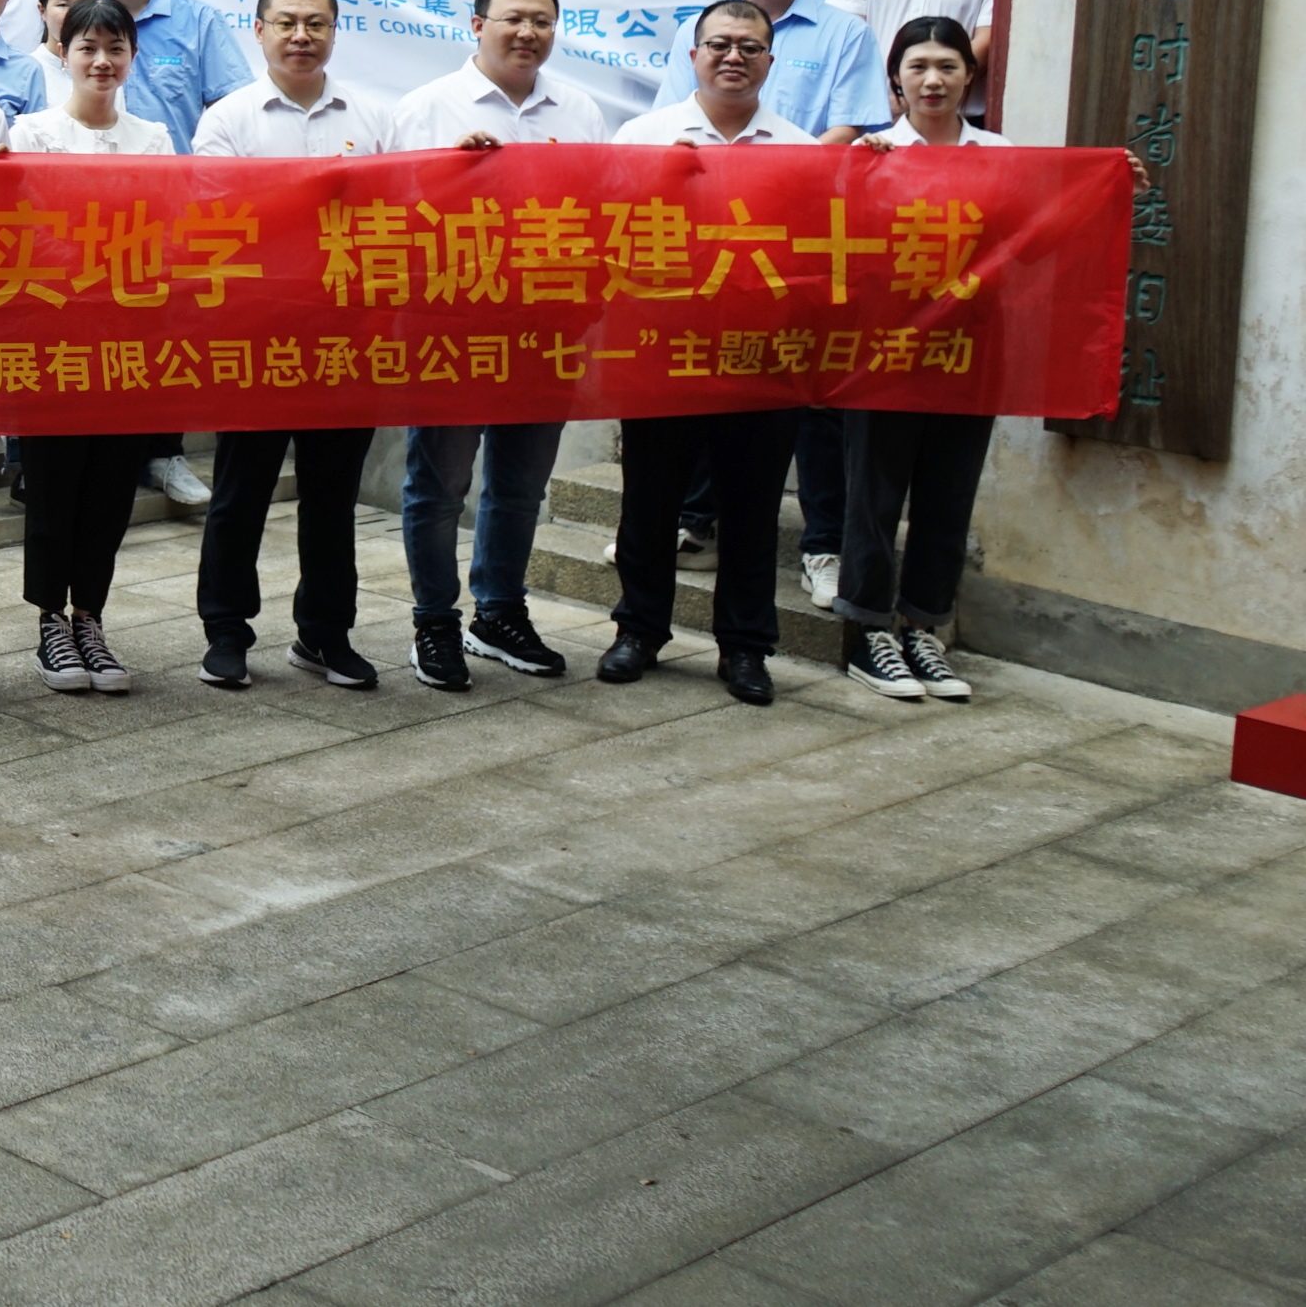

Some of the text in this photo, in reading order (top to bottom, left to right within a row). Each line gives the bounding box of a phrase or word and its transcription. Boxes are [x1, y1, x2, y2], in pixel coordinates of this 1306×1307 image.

[319, 197, 980, 309] 精诚善建六十载
